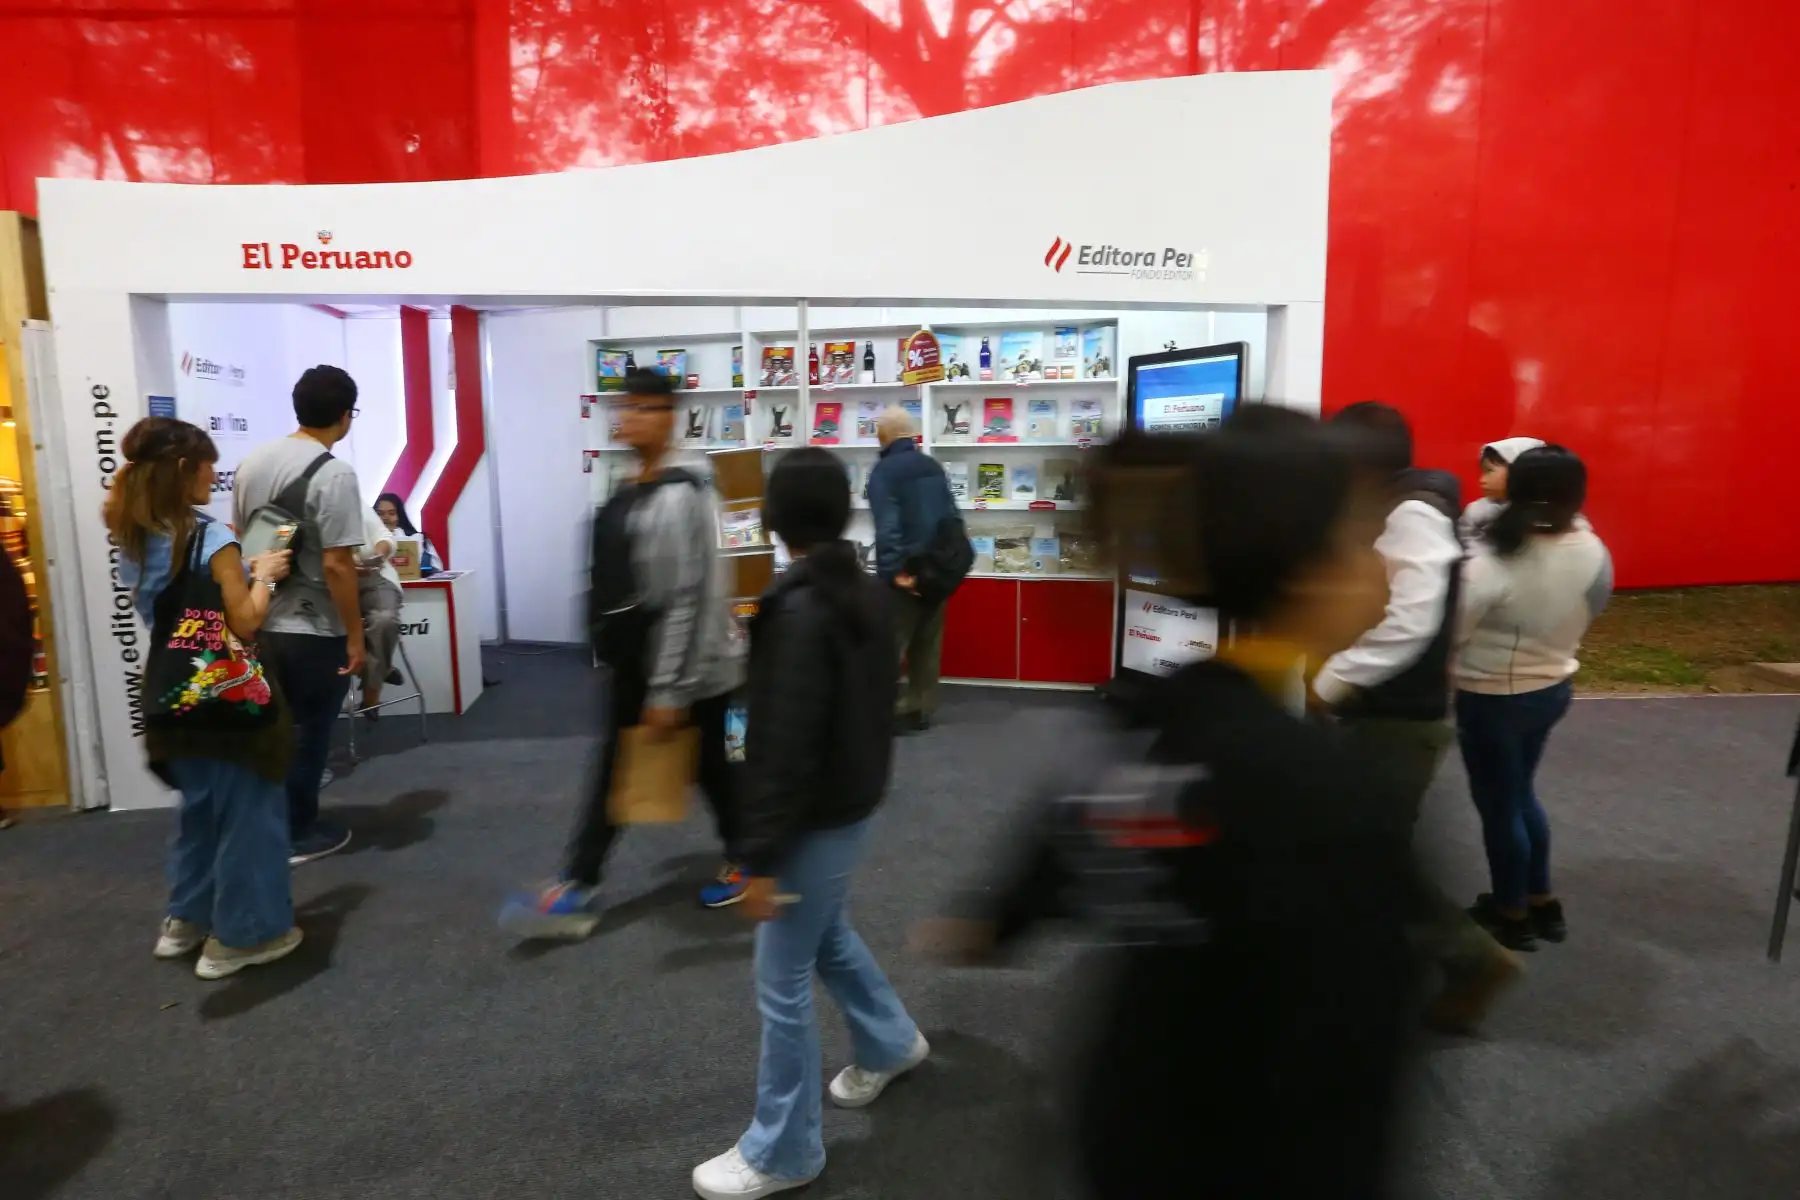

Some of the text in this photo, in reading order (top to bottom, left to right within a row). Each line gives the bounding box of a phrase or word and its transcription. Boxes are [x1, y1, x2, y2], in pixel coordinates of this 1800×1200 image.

[242, 243, 413, 269] El Peruano
[1078, 245, 1194, 268] Editora Per
[1131, 269, 1193, 281] FONDO EDITOR
[400, 618, 429, 636] erú
